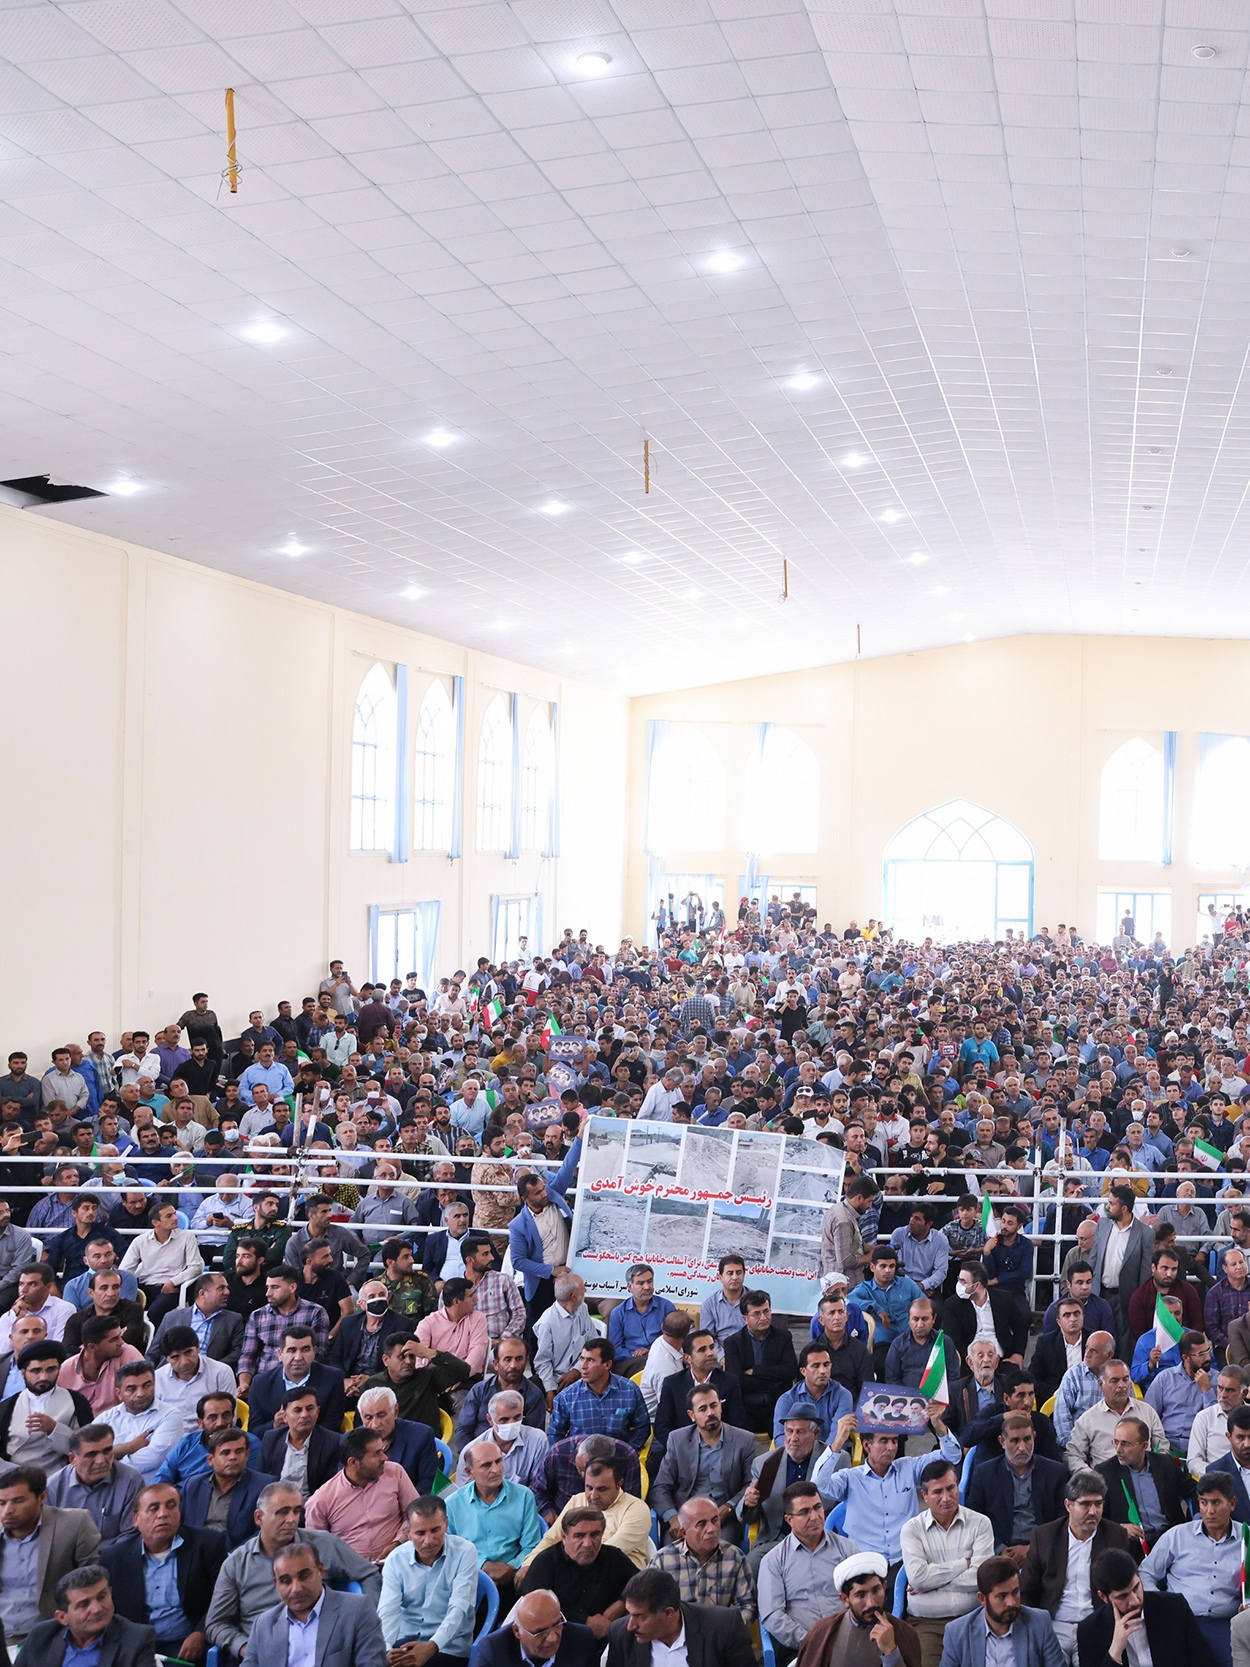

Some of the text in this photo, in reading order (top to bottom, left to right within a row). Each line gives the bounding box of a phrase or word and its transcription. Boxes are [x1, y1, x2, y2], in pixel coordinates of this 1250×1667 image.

[591, 1175, 624, 1192] آمدی
[624, 1178, 655, 1196] خوش
[655, 1183, 689, 1198] محترم
[734, 1189, 772, 1208] رئیس
[582, 1249, 599, 1260] نیست
[598, 1251, 620, 1263] پاسخگو
[620, 1252, 633, 1263] کس
[632, 1253, 644, 1264] هیچ
[645, 1253, 666, 1265] خیابانها
[666, 1255, 688, 1265] آسفالت
[687, 1257, 702, 1270] برای
[687, 1270, 711, 1282] رسیدگی
[775, 1267, 795, 1279] وضعیت
[795, 1268, 808, 1277] است
[807, 1269, 817, 1281] این
[584, 1279, 599, 1291] یوسف
[654, 1284, 678, 1296] اسلامی
[677, 1286, 699, 1298] شورای
